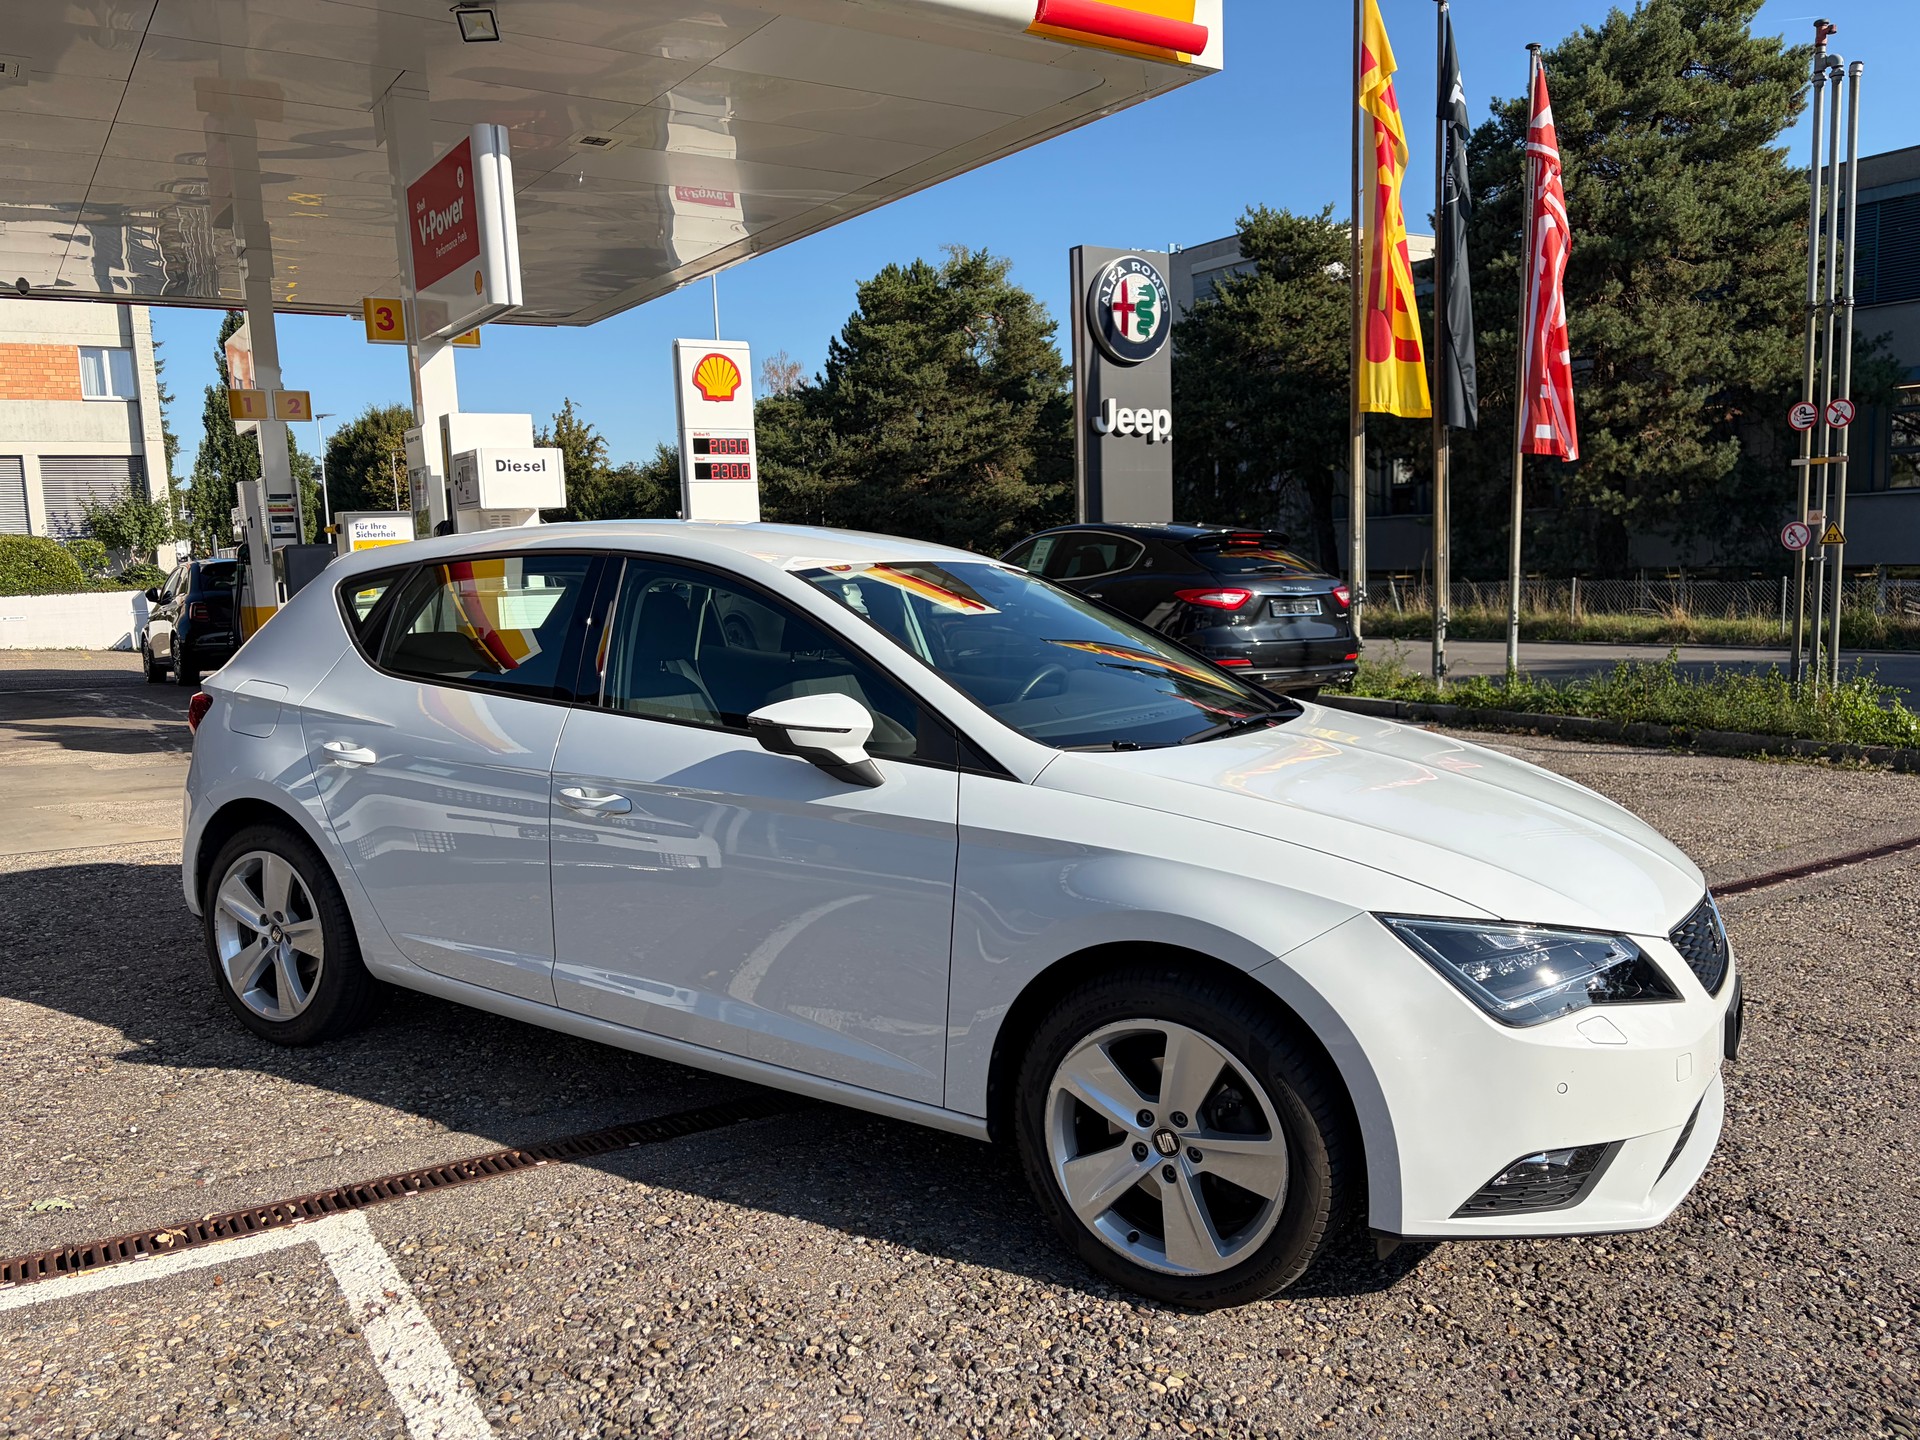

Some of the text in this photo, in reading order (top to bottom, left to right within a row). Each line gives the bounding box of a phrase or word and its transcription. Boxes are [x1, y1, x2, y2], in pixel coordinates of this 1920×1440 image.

[416, 197, 426, 214] Shell
[418, 195, 464, 246] V-Power
[435, 228, 468, 259] Performance Fuels
[1101, 261, 1169, 313] ALFA ROMEO
[376, 306, 395, 332] 3
[243, 397, 253, 413] 1
[287, 398, 301, 414] 2
[1092, 397, 1173, 442] Jeep
[709, 438, 749, 455] 209.0
[495, 458, 546, 472] Diesel
[711, 463, 751, 480] 230.0
[457, 471, 463, 492] 3
[247, 516, 254, 529] 1
[356, 530, 396, 538] Sicherheit
